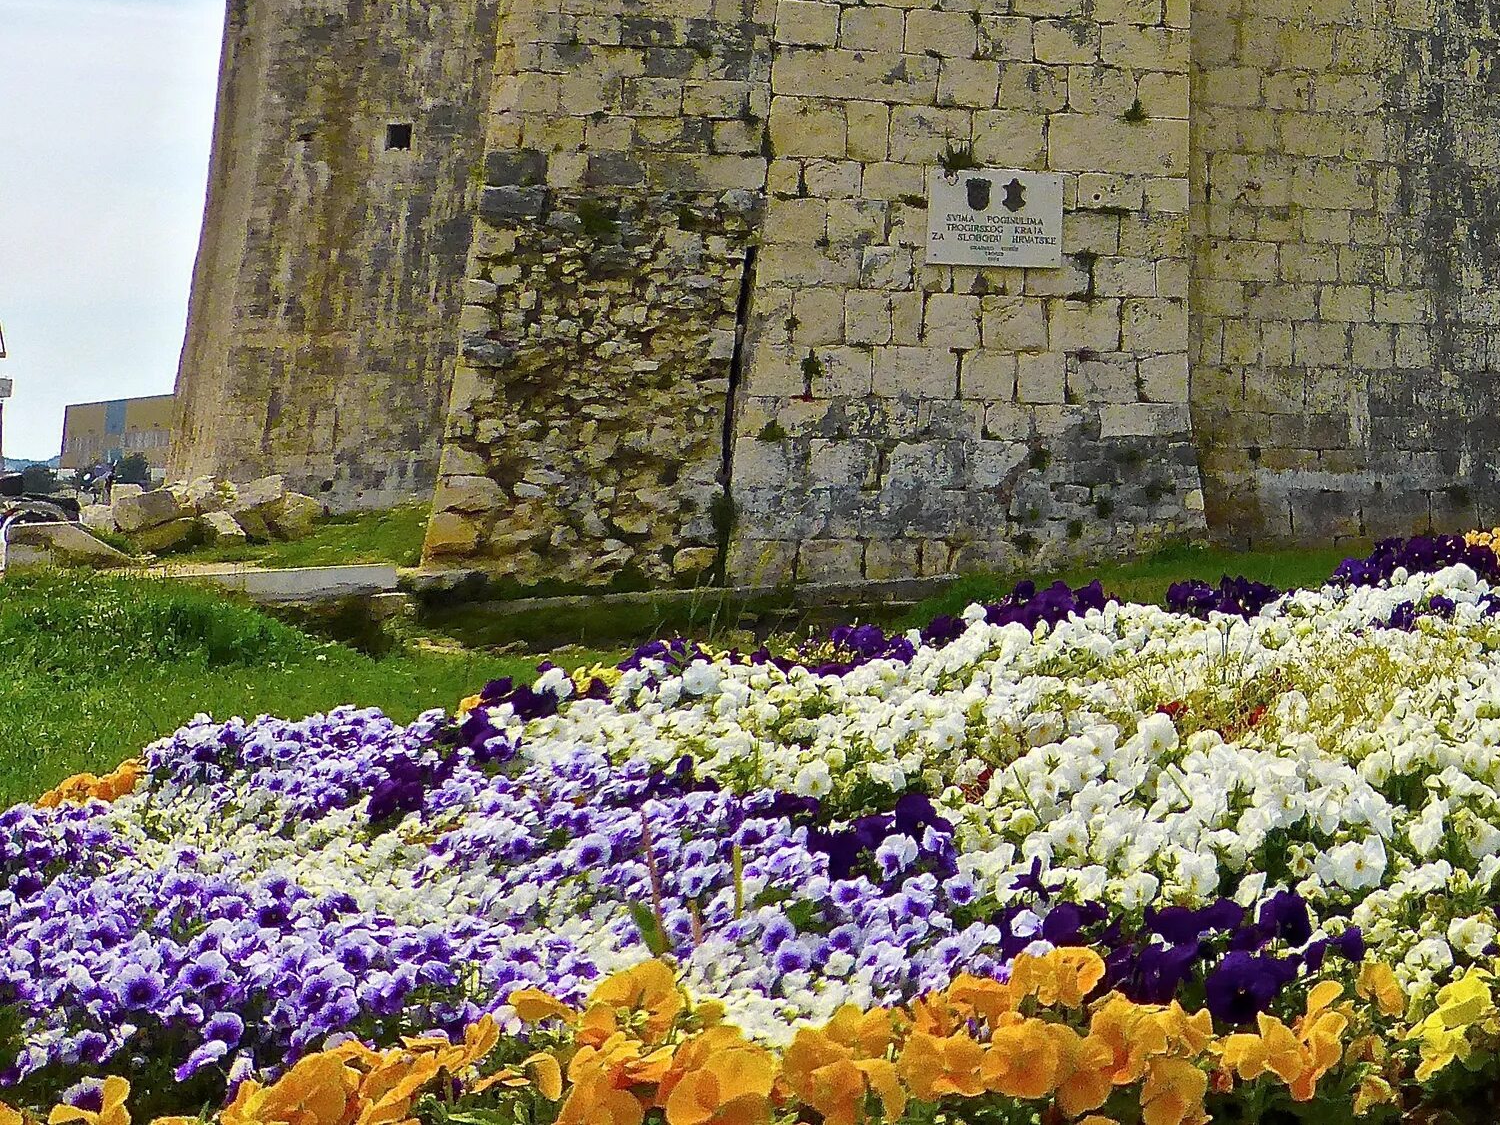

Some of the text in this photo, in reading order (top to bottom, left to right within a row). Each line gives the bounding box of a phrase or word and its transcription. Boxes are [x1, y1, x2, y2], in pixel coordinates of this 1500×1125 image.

[946, 214, 1044, 226] SVIMA POGINULIMA
[946, 223, 1043, 235] TROGIRSKOG KRAJA
[931, 232, 1056, 245] ZA SLOBODU HRVATSKE
